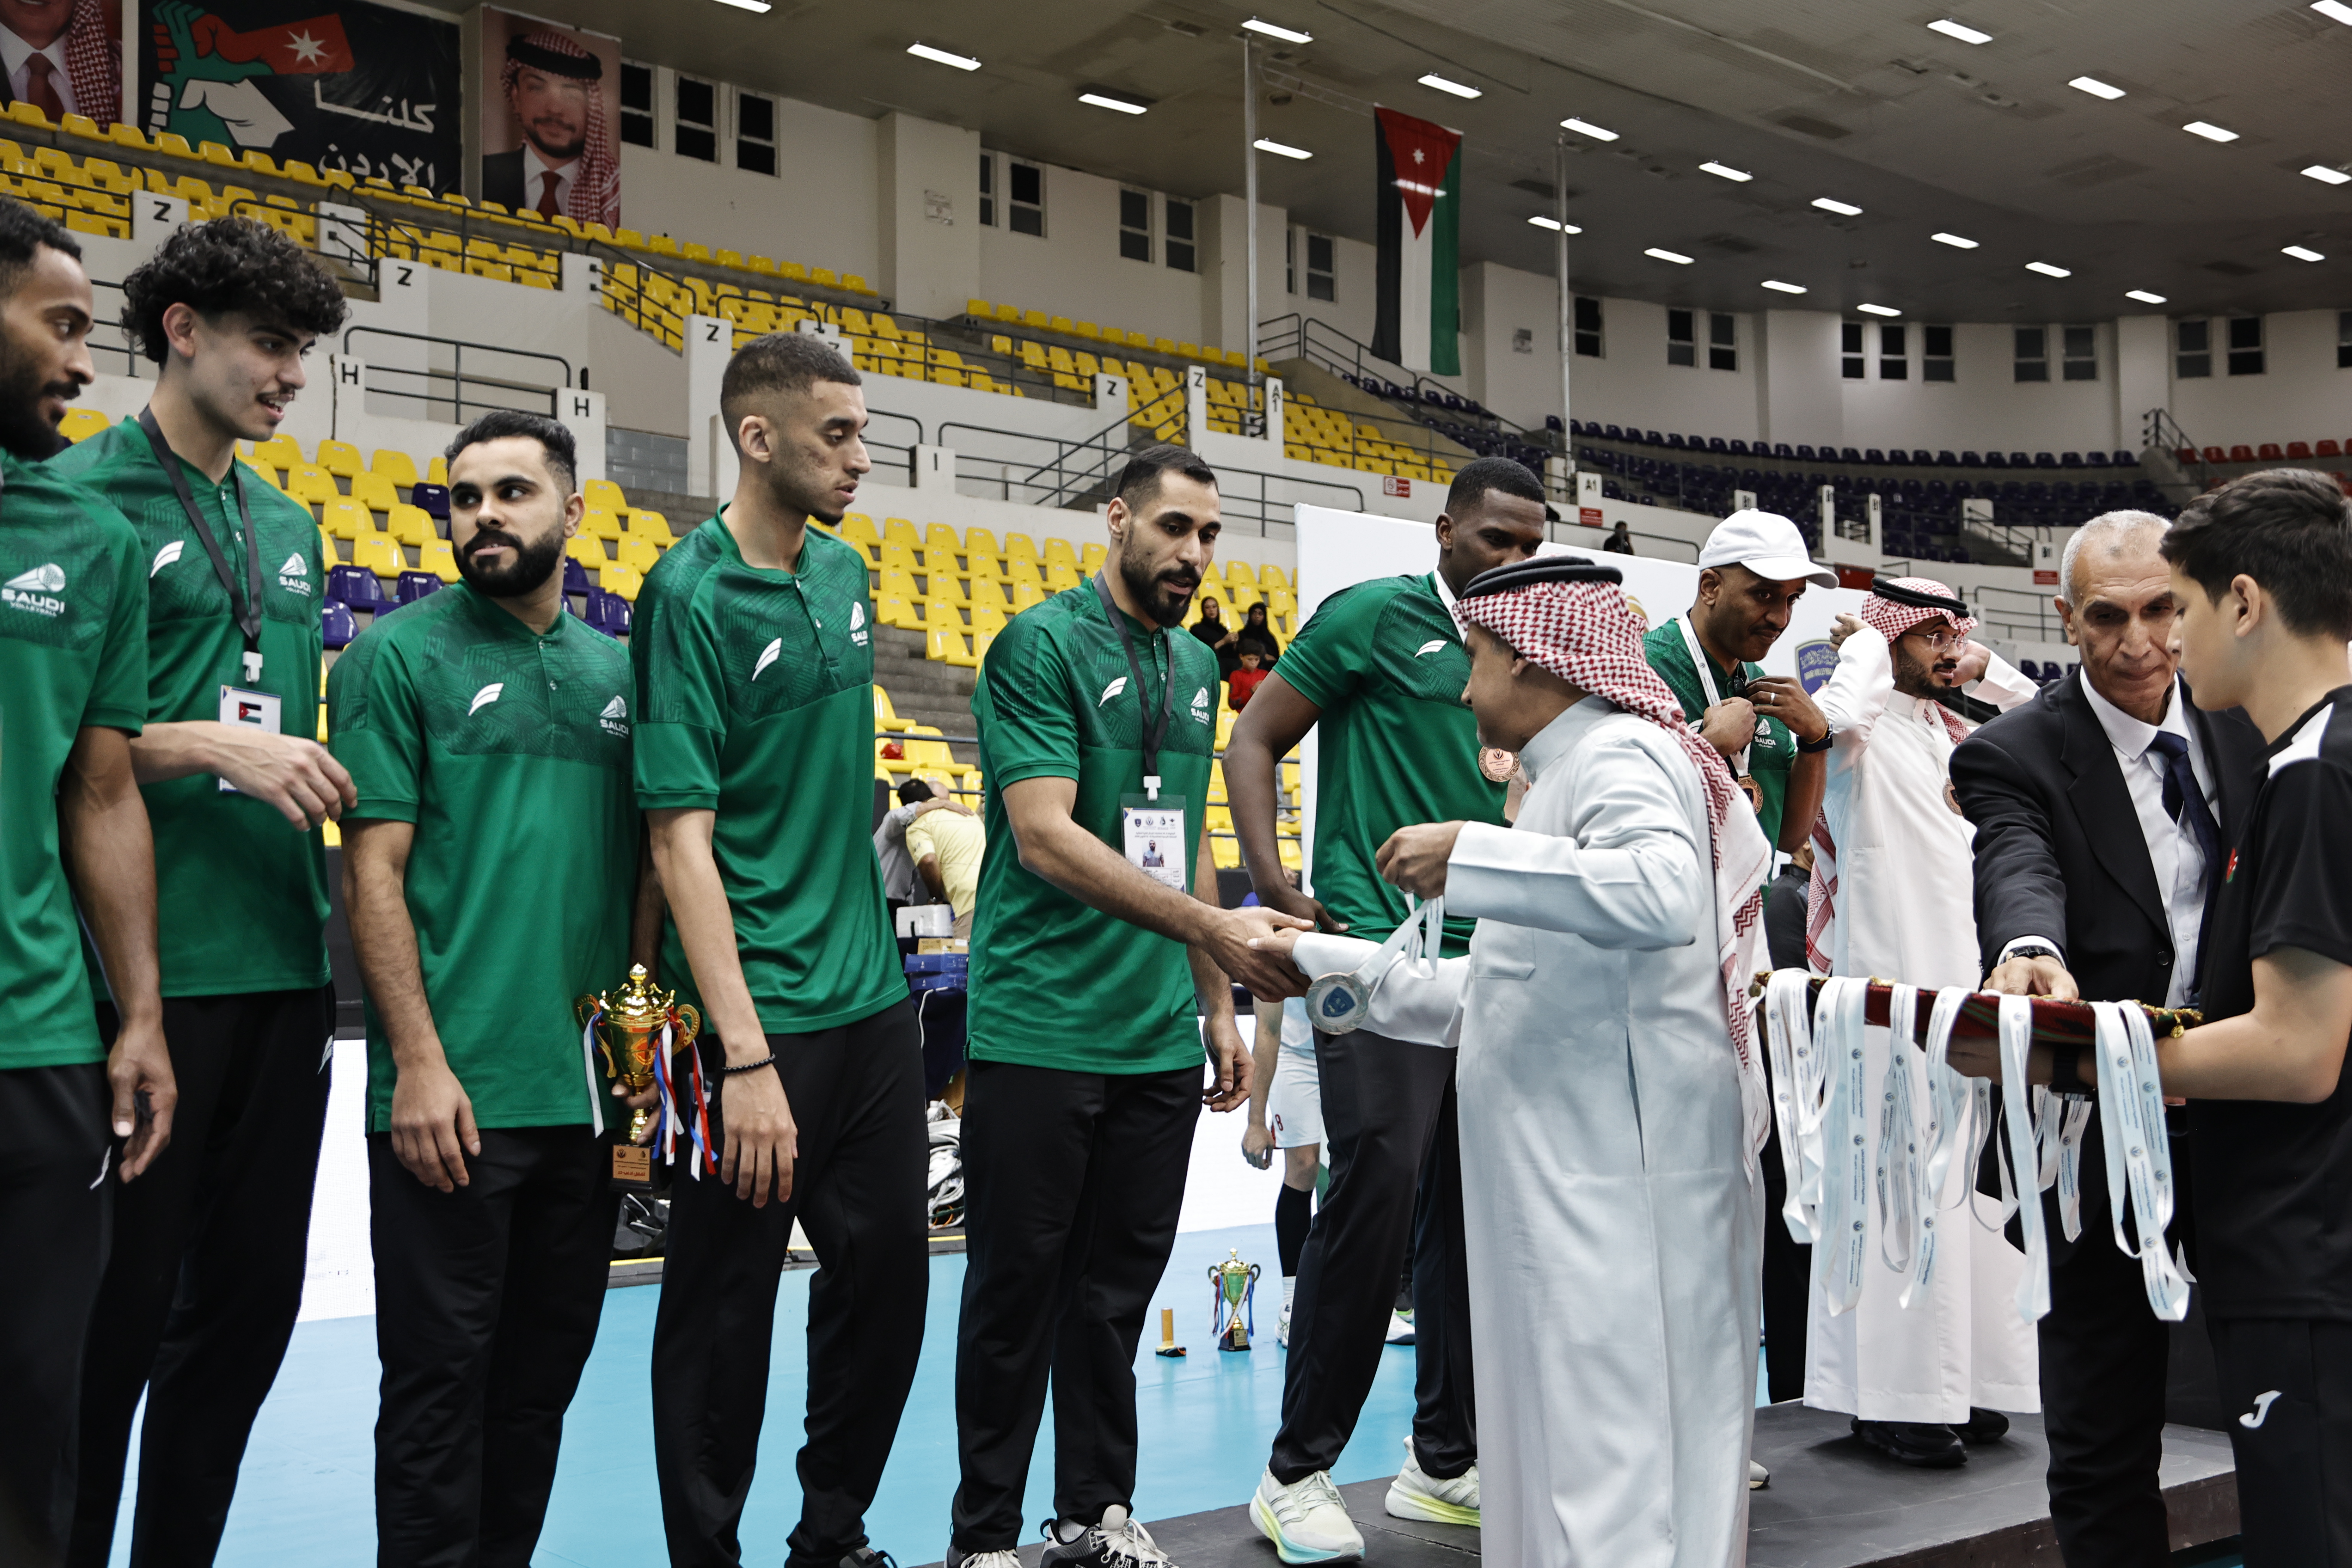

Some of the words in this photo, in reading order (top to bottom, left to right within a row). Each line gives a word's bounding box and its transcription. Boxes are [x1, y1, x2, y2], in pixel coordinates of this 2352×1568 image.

[153, 201, 171, 223] Z
[398, 266, 412, 287] Z
[706, 324, 720, 342] Z
[342, 363, 358, 385] H
[1194, 372, 1204, 388] Z
[1107, 381, 1117, 396] Z
[574, 397, 589, 417] H
[1586, 478, 1597, 491] A1
[279, 576, 311, 593] SAUDI
[2, 588, 65, 614] SAUDI
[1191, 707, 1209, 722] SAUDI
[600, 719, 629, 735] SAUDI
[1755, 735, 1776, 746] SAUDI
[1275, 1114, 1284, 1131] 8
